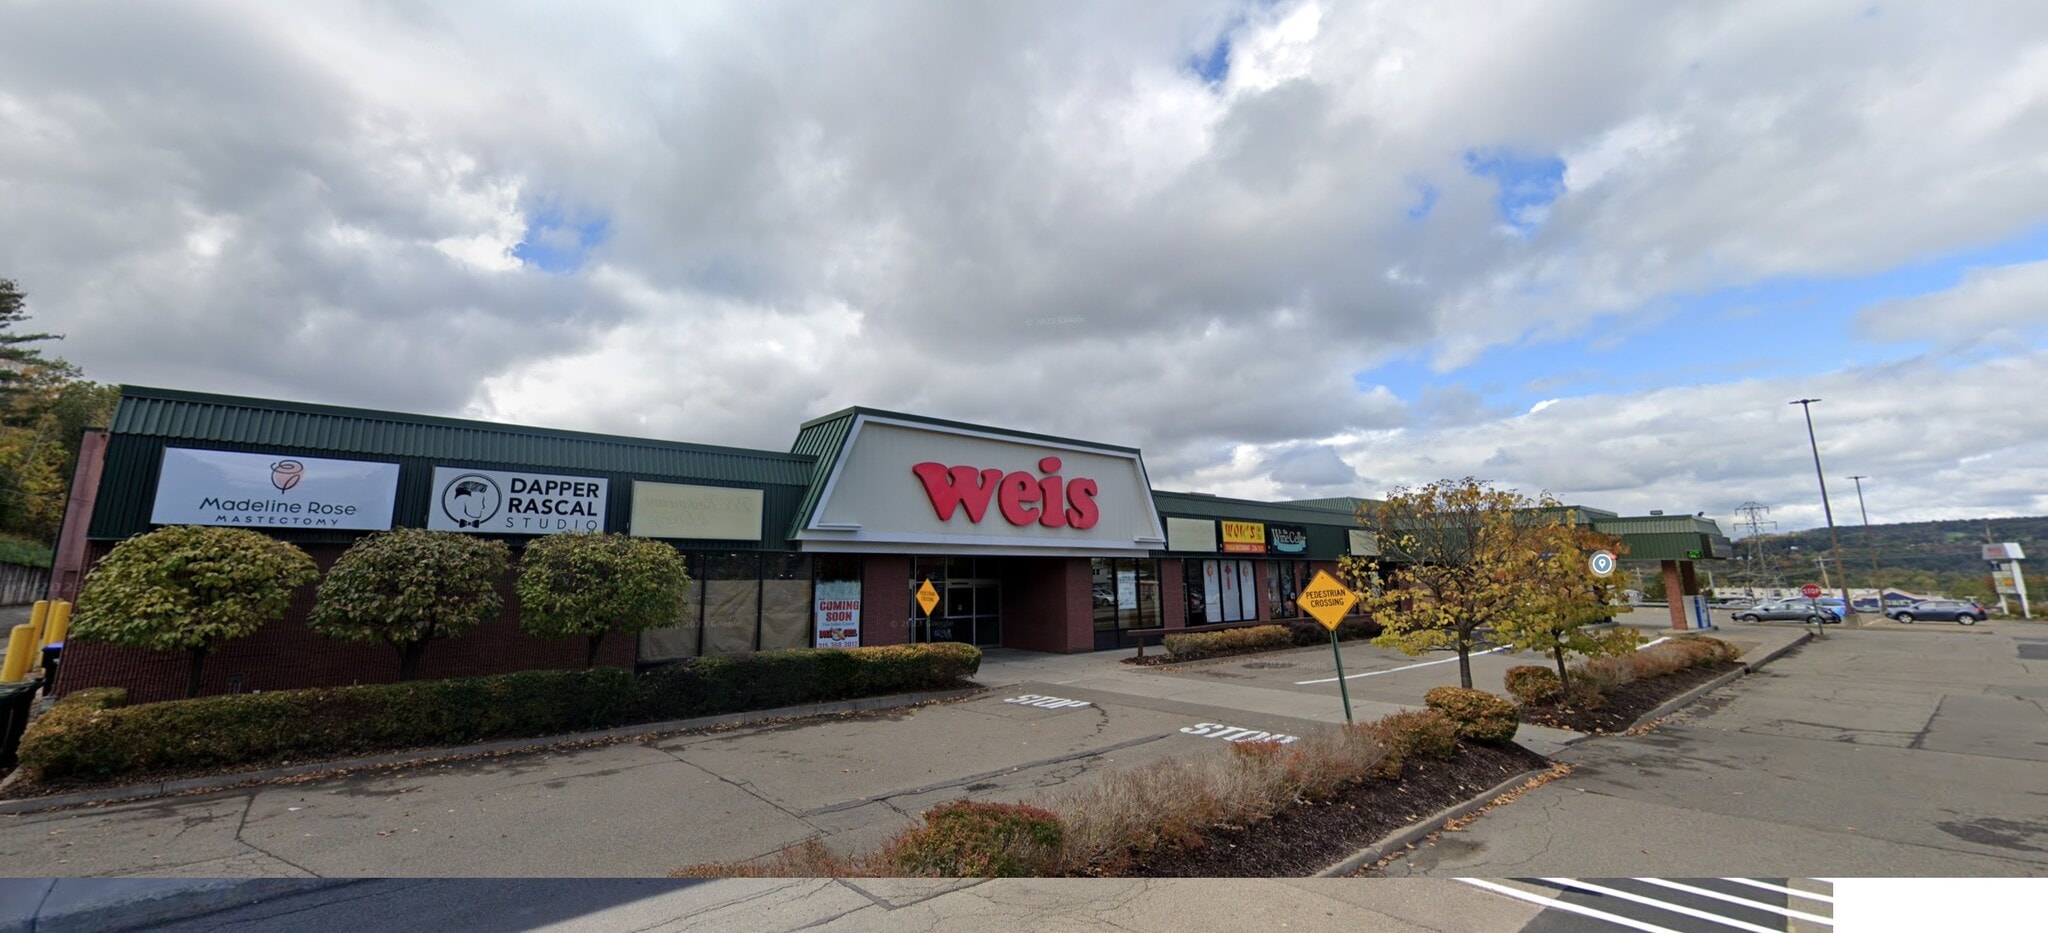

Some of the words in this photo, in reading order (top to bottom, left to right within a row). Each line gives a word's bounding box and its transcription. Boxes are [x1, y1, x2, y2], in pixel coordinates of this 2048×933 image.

[510, 477, 600, 498] DAPPER
[912, 456, 1100, 530] weis
[199, 497, 302, 514] Madeline
[307, 501, 357, 516] Rose
[507, 497, 598, 517] RASCAL
[215, 515, 339, 526] MASTECTOMY
[506, 516, 598, 530] STUDIO
[1305, 588, 1346, 599] PEDESTRIAN
[819, 600, 860, 611] COMING
[1310, 597, 1345, 608] CROSSING
[825, 611, 852, 622] SOON
[1003, 694, 1091, 709] STOP
